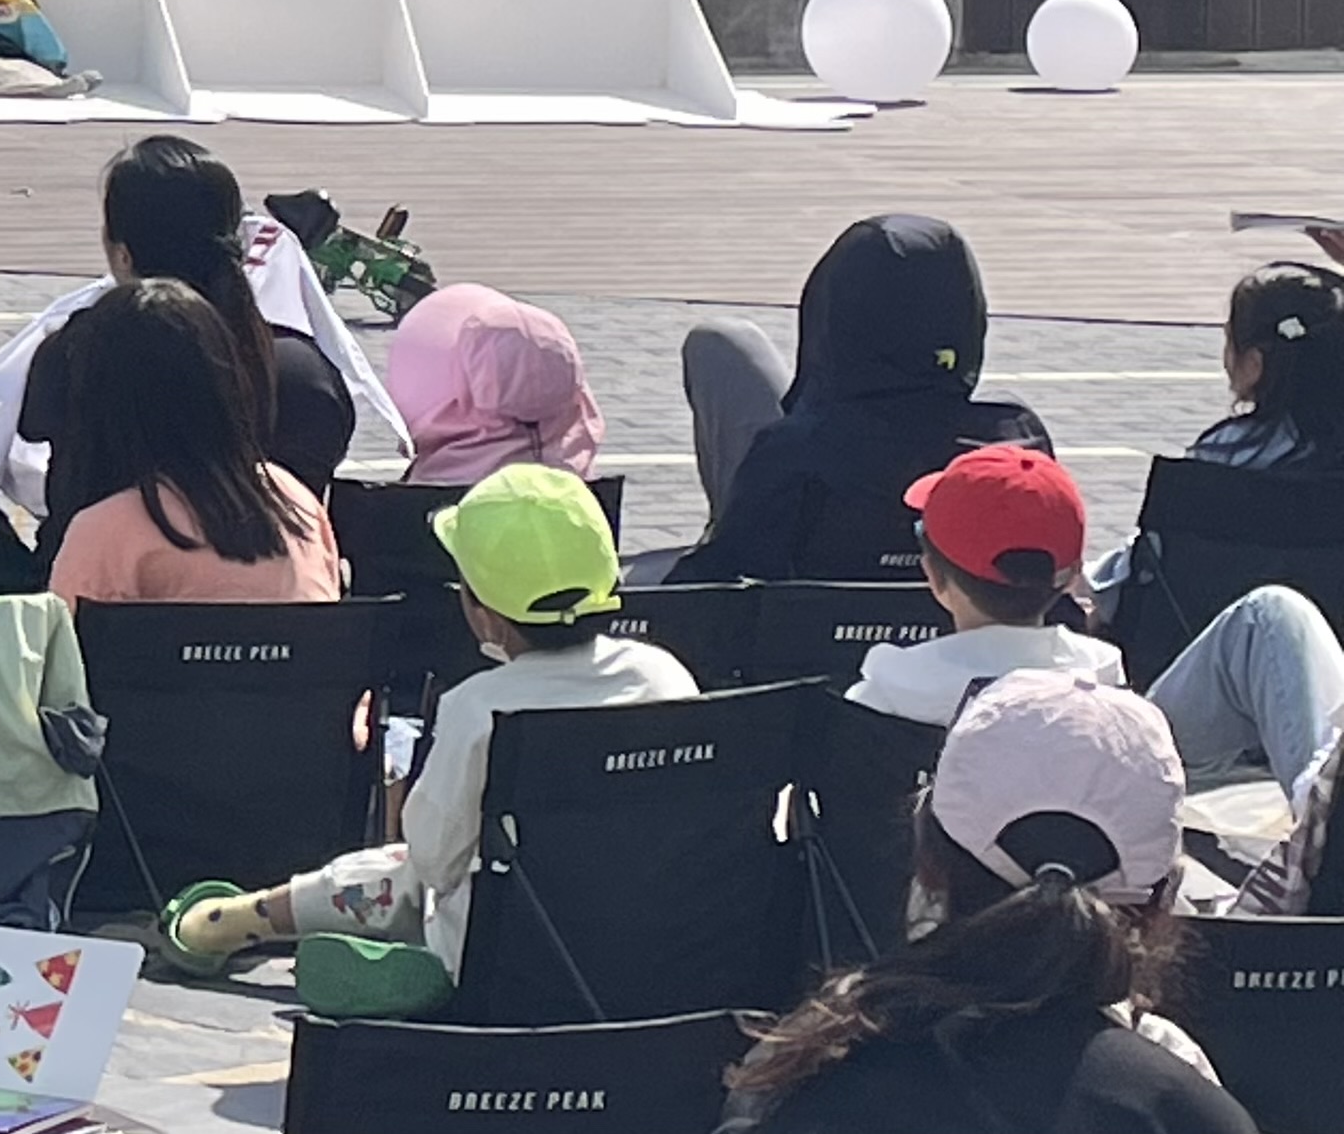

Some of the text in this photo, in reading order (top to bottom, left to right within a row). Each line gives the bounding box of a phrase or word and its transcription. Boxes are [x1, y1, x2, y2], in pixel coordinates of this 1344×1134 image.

[609, 619, 650, 634] PEAK
[833, 625, 939, 641] BREEZE PEAK
[181, 645, 291, 661] BREEZE PEAK
[605, 743, 716, 772] BREEZE PEAK
[1232, 969, 1317, 990] BREEZE
[448, 1089, 606, 1112] BREEZE PEAK
